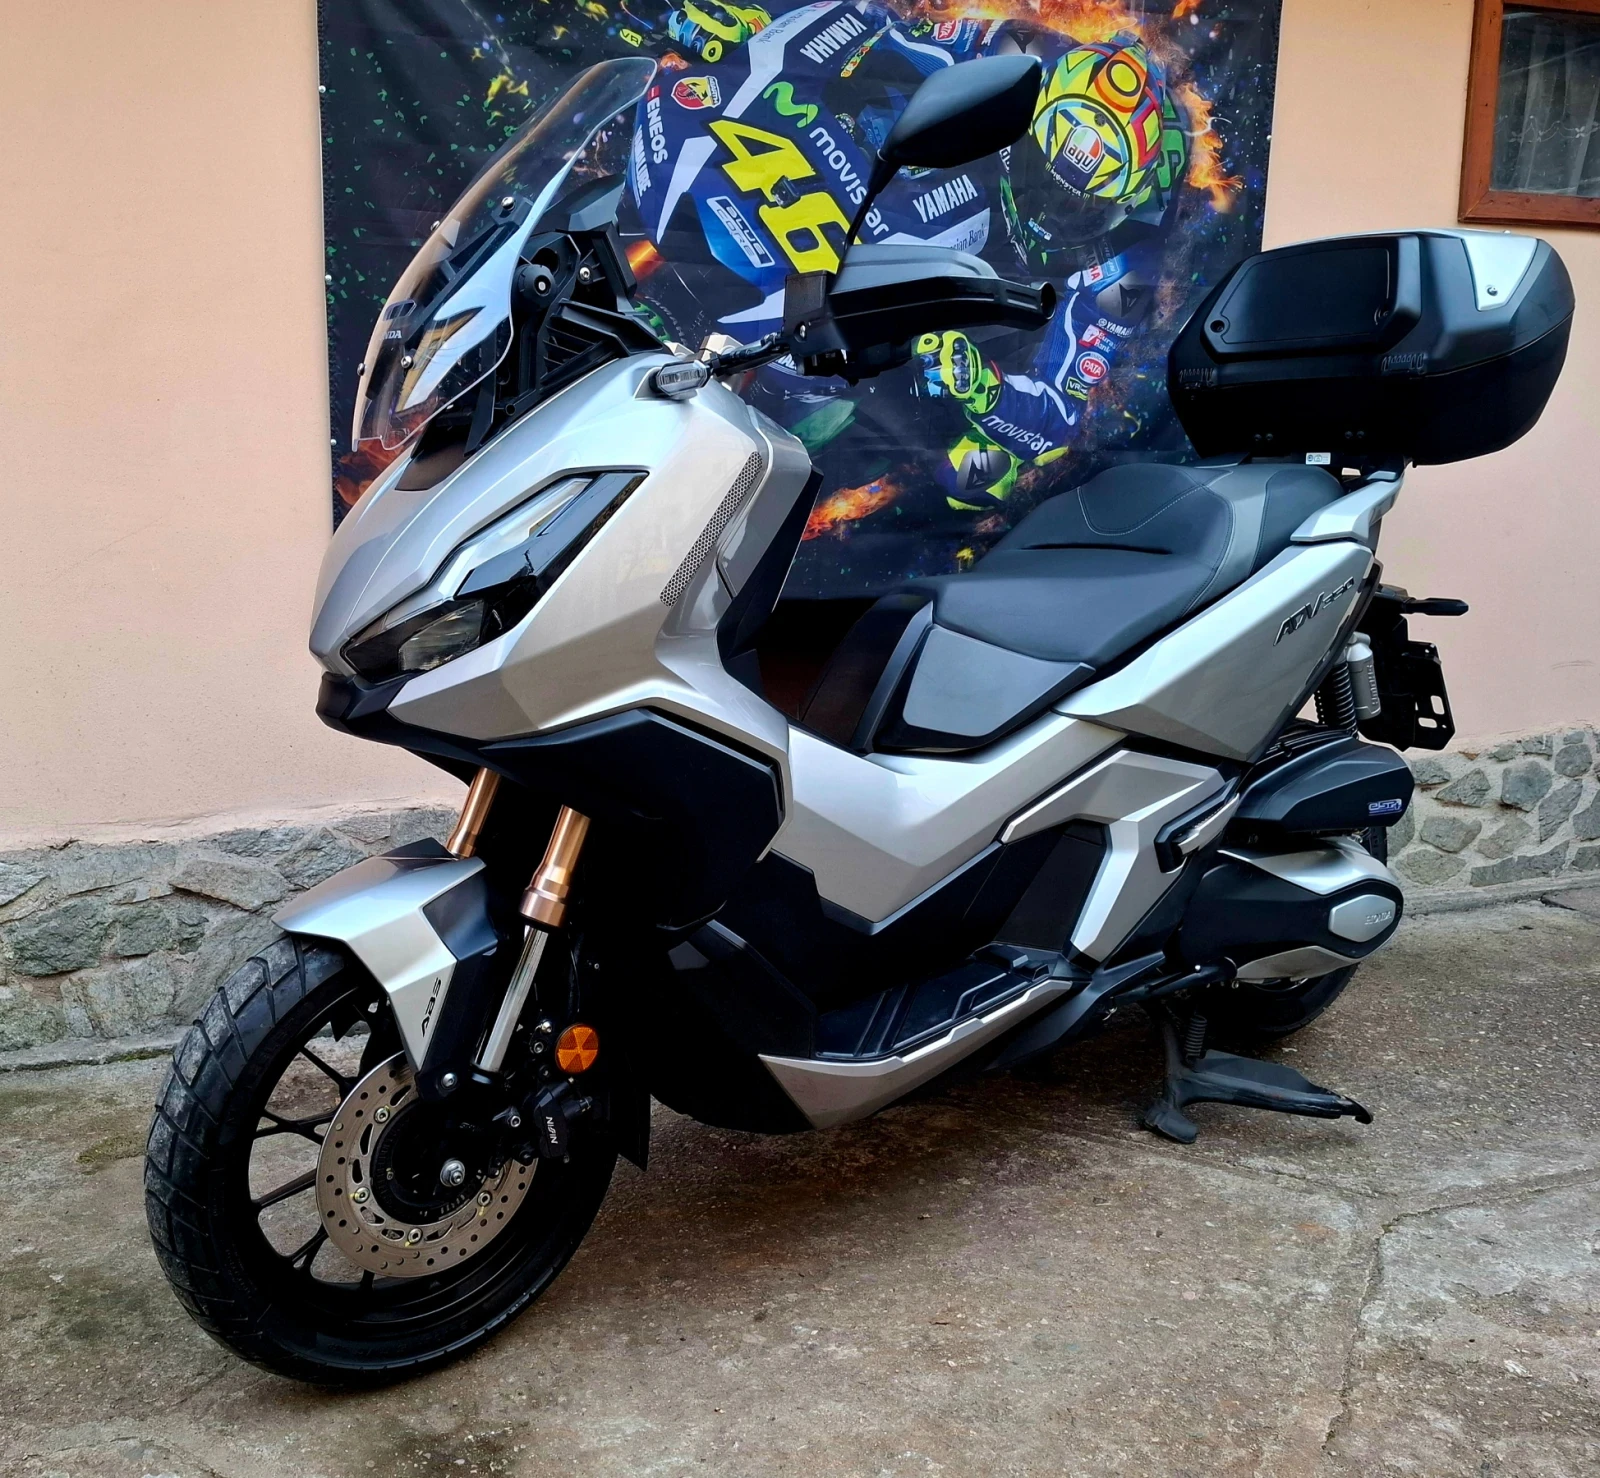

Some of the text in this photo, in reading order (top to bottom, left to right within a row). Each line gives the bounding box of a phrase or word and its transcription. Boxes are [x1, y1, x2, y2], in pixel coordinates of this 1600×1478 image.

[800, 13, 868, 64] YAMAHA
[646, 97, 669, 164] ENEOS
[1066, 143, 1094, 169] agv
[708, 119, 862, 274] 46
[808, 126, 890, 236] movisar
[912, 173, 979, 224] YAMAHA
[716, 208, 756, 257] CORE
[725, 205, 766, 257] BLUE
[1082, 360, 1102, 377] PATA
[981, 414, 1054, 456] movistar
[421, 976, 442, 1038] ABS
